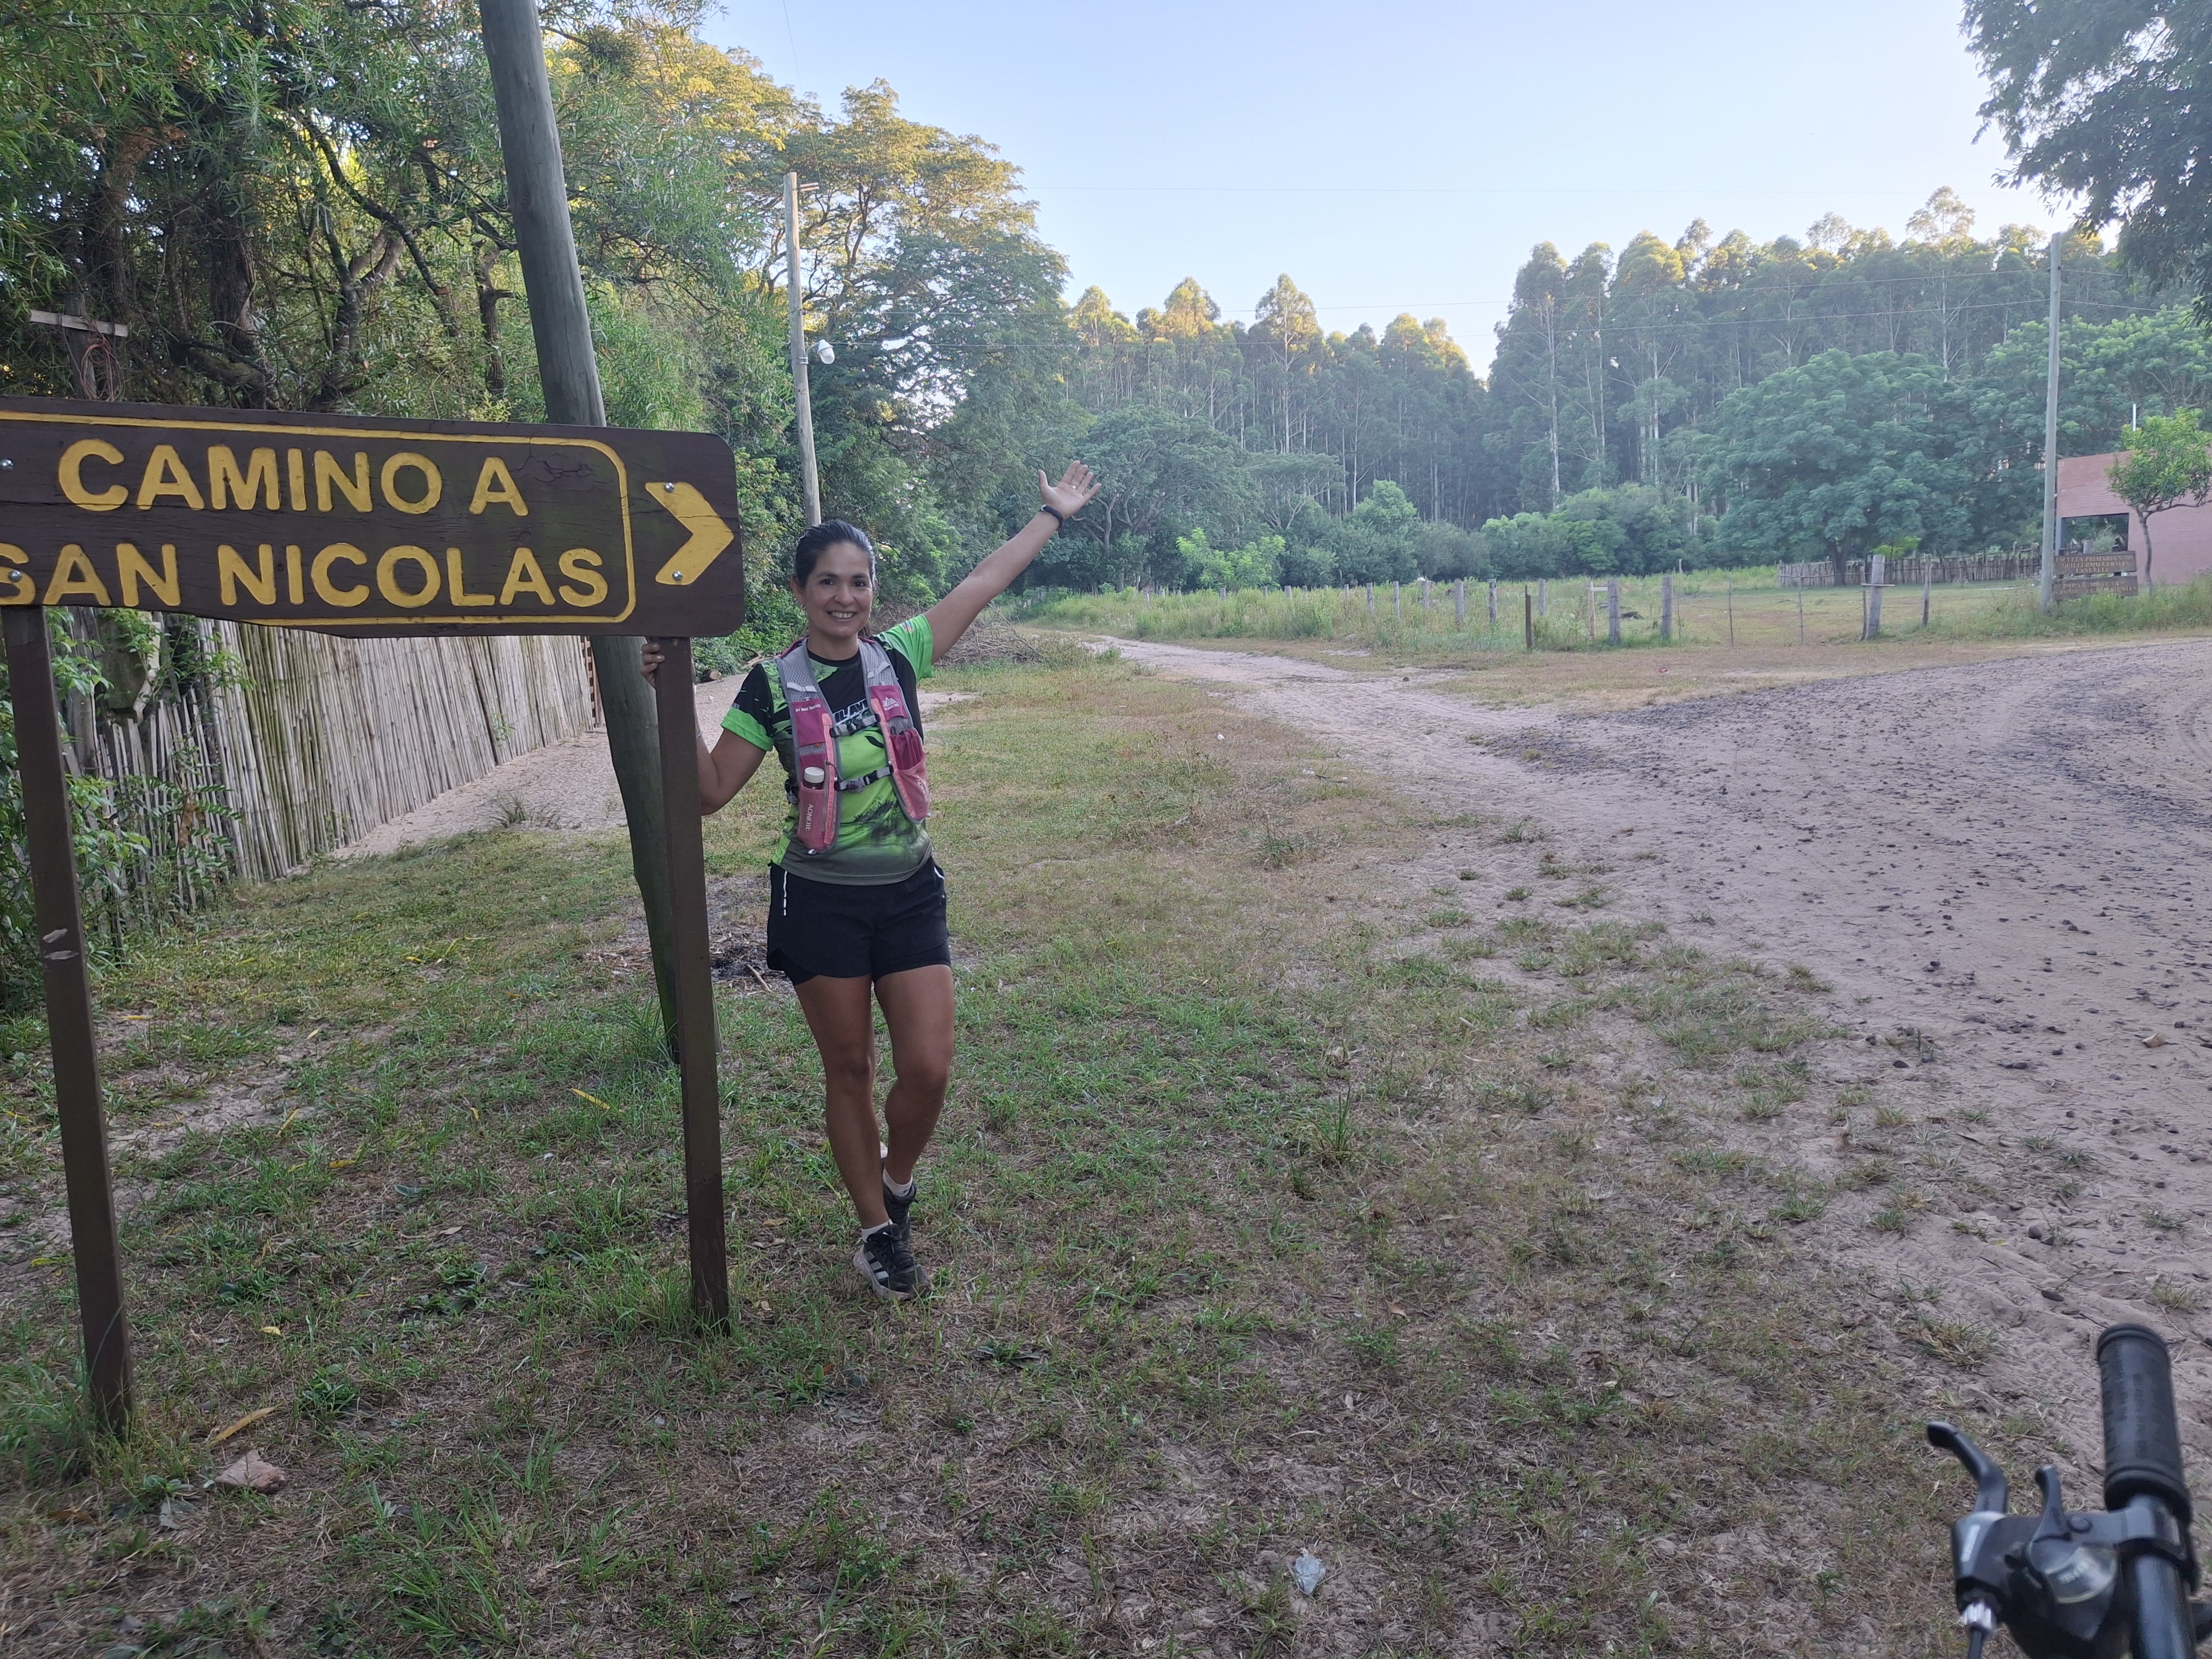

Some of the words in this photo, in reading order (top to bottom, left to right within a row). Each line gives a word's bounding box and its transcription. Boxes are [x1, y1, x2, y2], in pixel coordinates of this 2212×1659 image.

[58, 439, 442, 515] CAMINO
[470, 458, 529, 517] A
[0, 542, 182, 607] SAN
[217, 543, 609, 608] NICOLAS
[806, 803, 814, 831] AONIJIE
